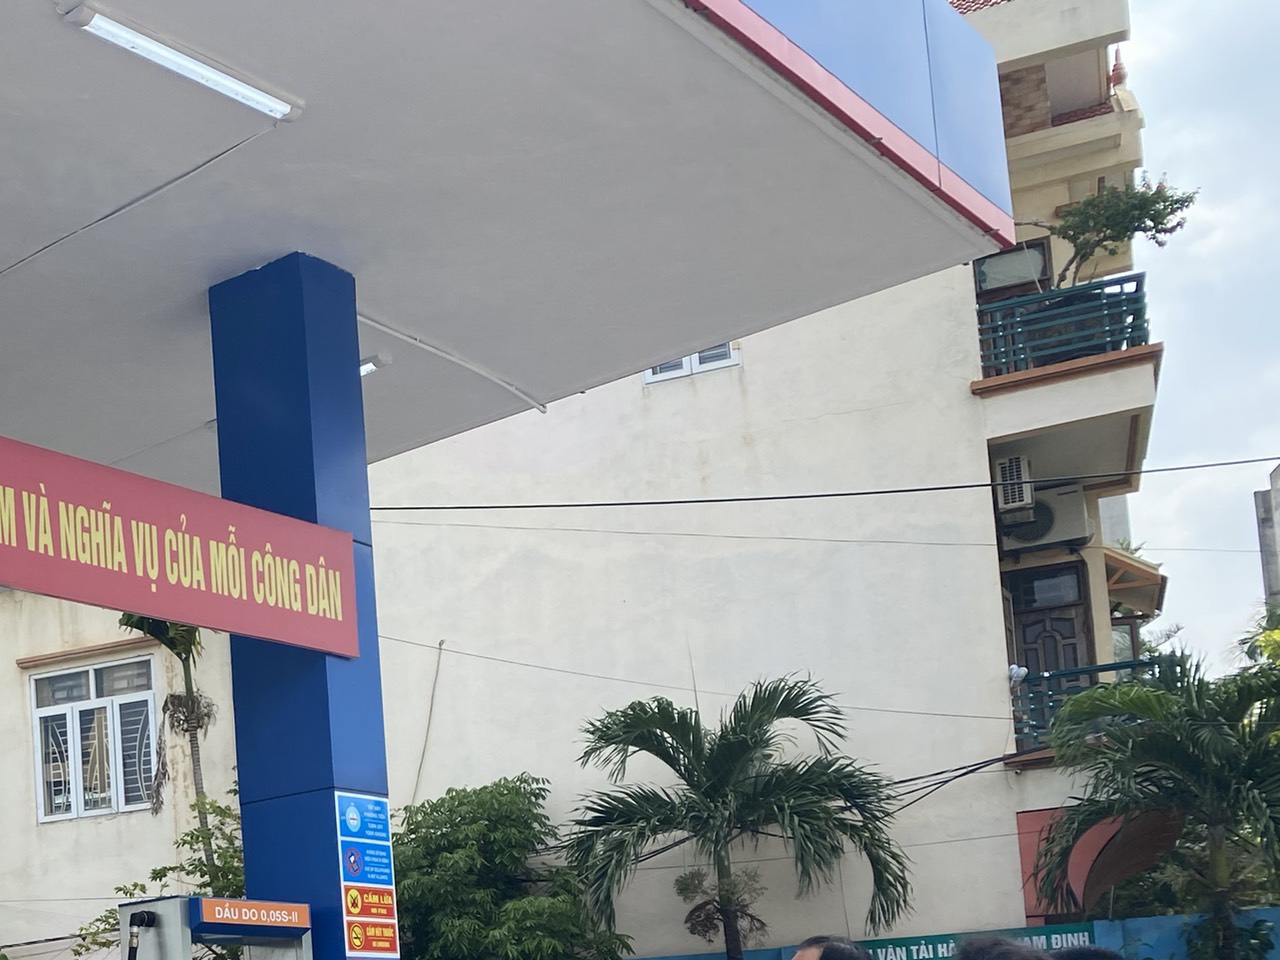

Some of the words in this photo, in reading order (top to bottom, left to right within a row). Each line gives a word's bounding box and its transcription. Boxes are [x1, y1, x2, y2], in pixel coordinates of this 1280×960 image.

[24, 482, 56, 558] VÀ
[59, 500, 127, 568] NGHĨA
[130, 534, 159, 592] VỤ
[164, 514, 205, 587] CỦA
[209, 523, 249, 600] MỖI
[251, 546, 302, 614] CÔNG
[306, 555, 344, 622] DÂN
[215, 903, 239, 920] DẦU
[242, 910, 258, 921] DO
[910, 941, 933, 959] TẢI
